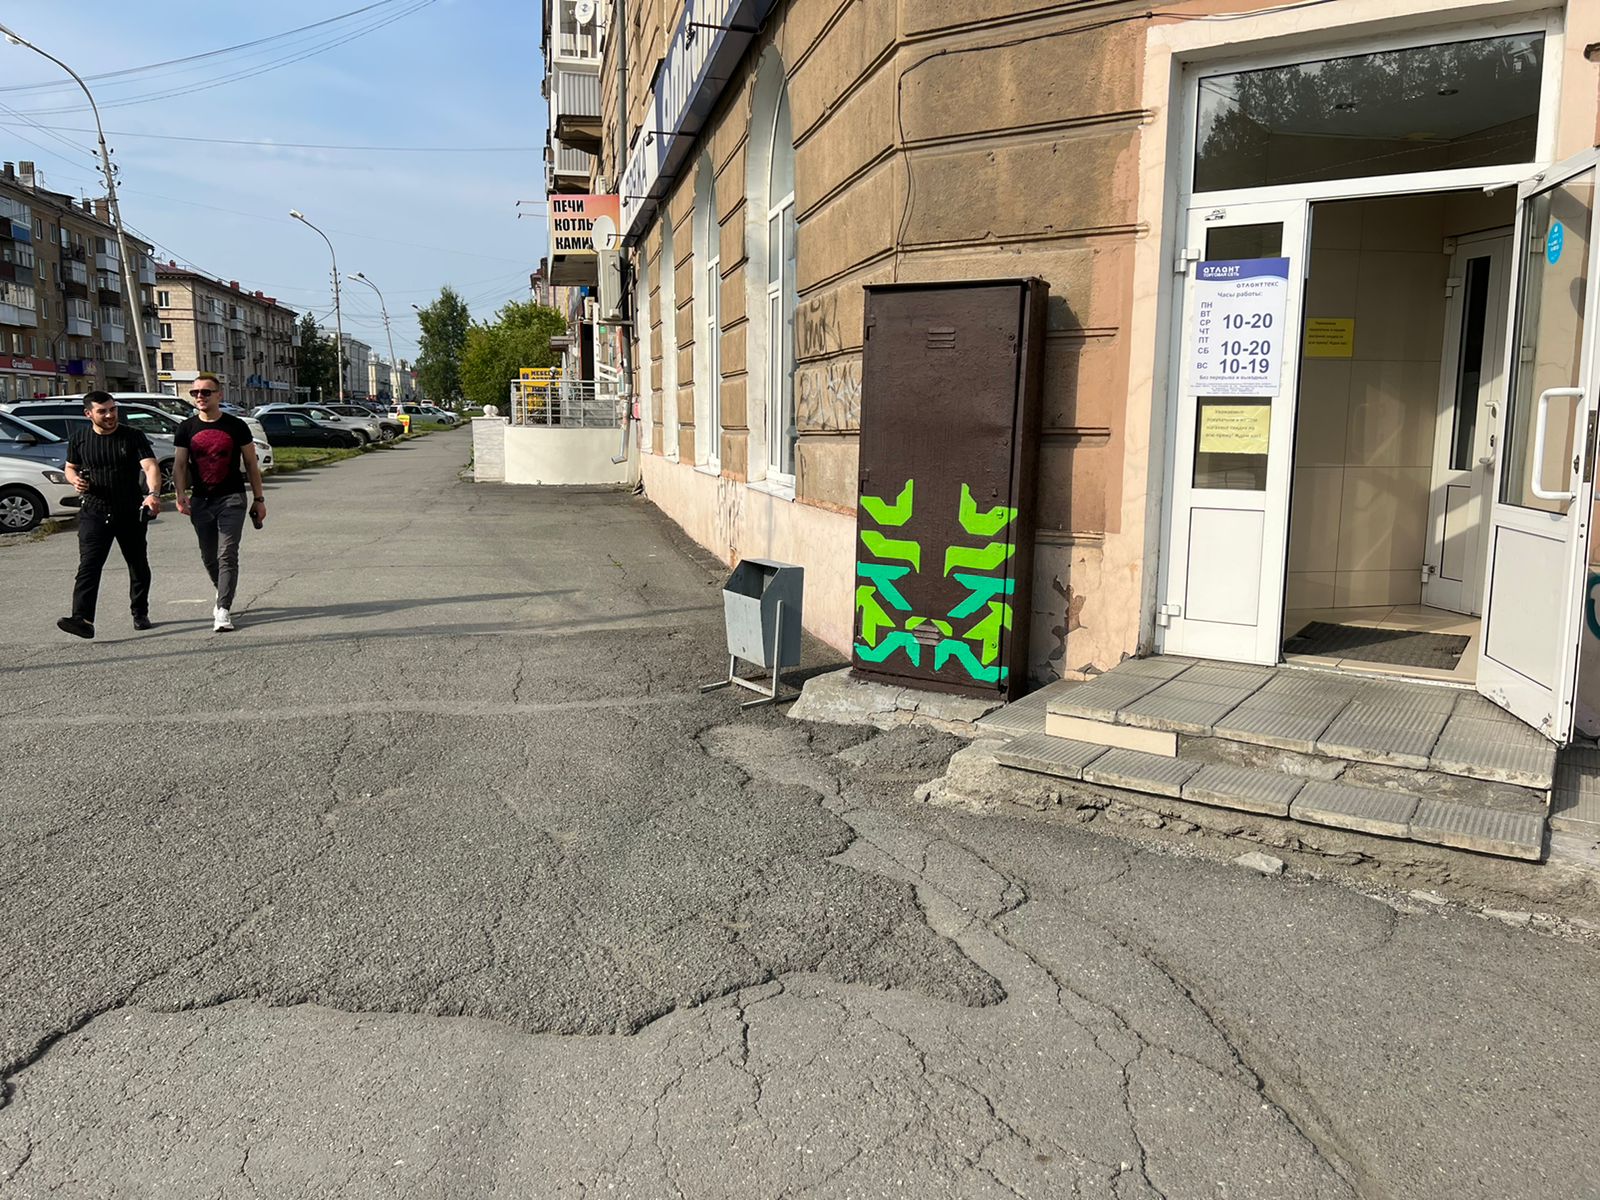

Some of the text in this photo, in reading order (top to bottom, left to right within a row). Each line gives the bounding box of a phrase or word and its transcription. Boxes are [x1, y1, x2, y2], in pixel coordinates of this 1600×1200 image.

[553, 200, 584, 212] ПЕЧИ
[1223, 313, 1273, 329] 10-20
[1221, 340, 1271, 356] 10-20
[1219, 358, 1269, 374] 10-19
